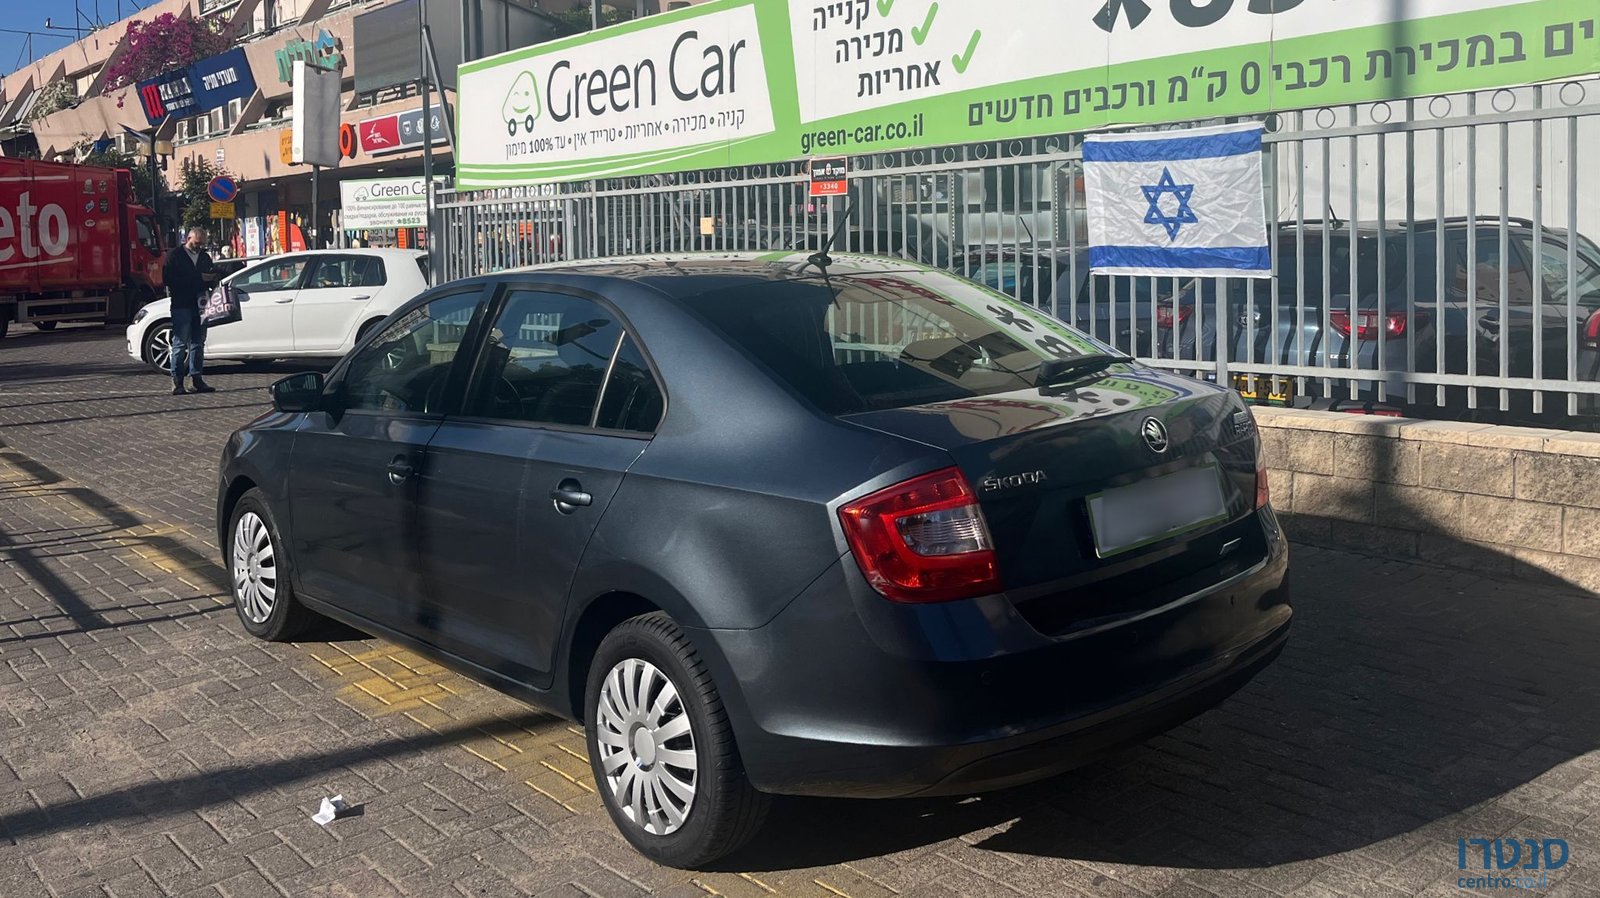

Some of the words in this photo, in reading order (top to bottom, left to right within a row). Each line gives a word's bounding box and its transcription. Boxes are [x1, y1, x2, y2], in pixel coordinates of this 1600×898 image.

[813, 0, 870, 31] קנייה
[836, 28, 903, 63] מכירה
[1364, 32, 1526, 82] במכירת
[547, 57, 656, 122] Green
[669, 30, 746, 101] Car
[858, 60, 941, 97] אחריות
[1241, 61, 1260, 95] 0
[1276, 54, 1350, 90] רכבי
[969, 92, 1053, 127] חדשים
[1064, 77, 1156, 116] ורכבים
[625, 120, 662, 140] אחריות
[673, 112, 706, 134] מכירה
[717, 108, 745, 130] קניה
[801, 113, 923, 154] green-car.co.il
[506, 142, 526, 160] מימון
[529, 138, 553, 153] 100%
[554, 134, 566, 149] עד
[371, 184, 408, 196] Green
[412, 181, 427, 195] Ca
[984, 470, 1047, 492] ŠKODA
